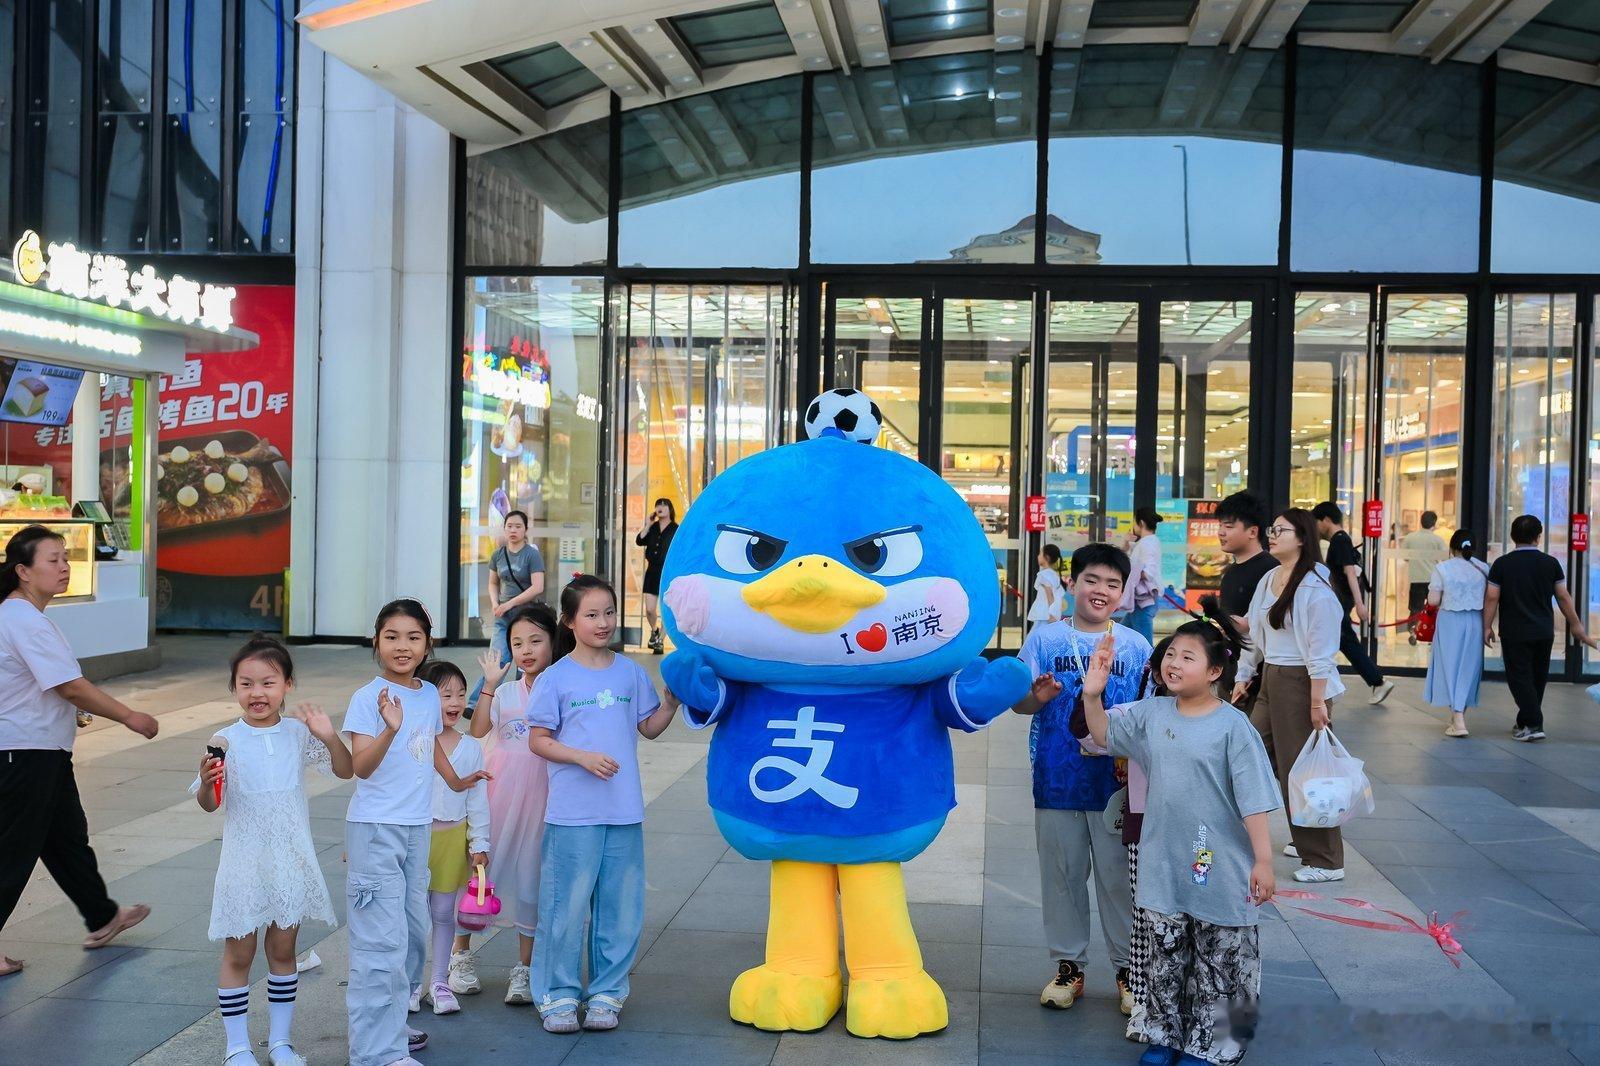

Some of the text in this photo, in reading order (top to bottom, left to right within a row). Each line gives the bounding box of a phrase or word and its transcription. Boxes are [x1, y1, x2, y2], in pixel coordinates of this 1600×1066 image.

[894, 605, 936, 622] NANJING
[891, 613, 944, 646] 南京
[571, 697, 597, 707] Musical
[749, 706, 859, 809] 支
